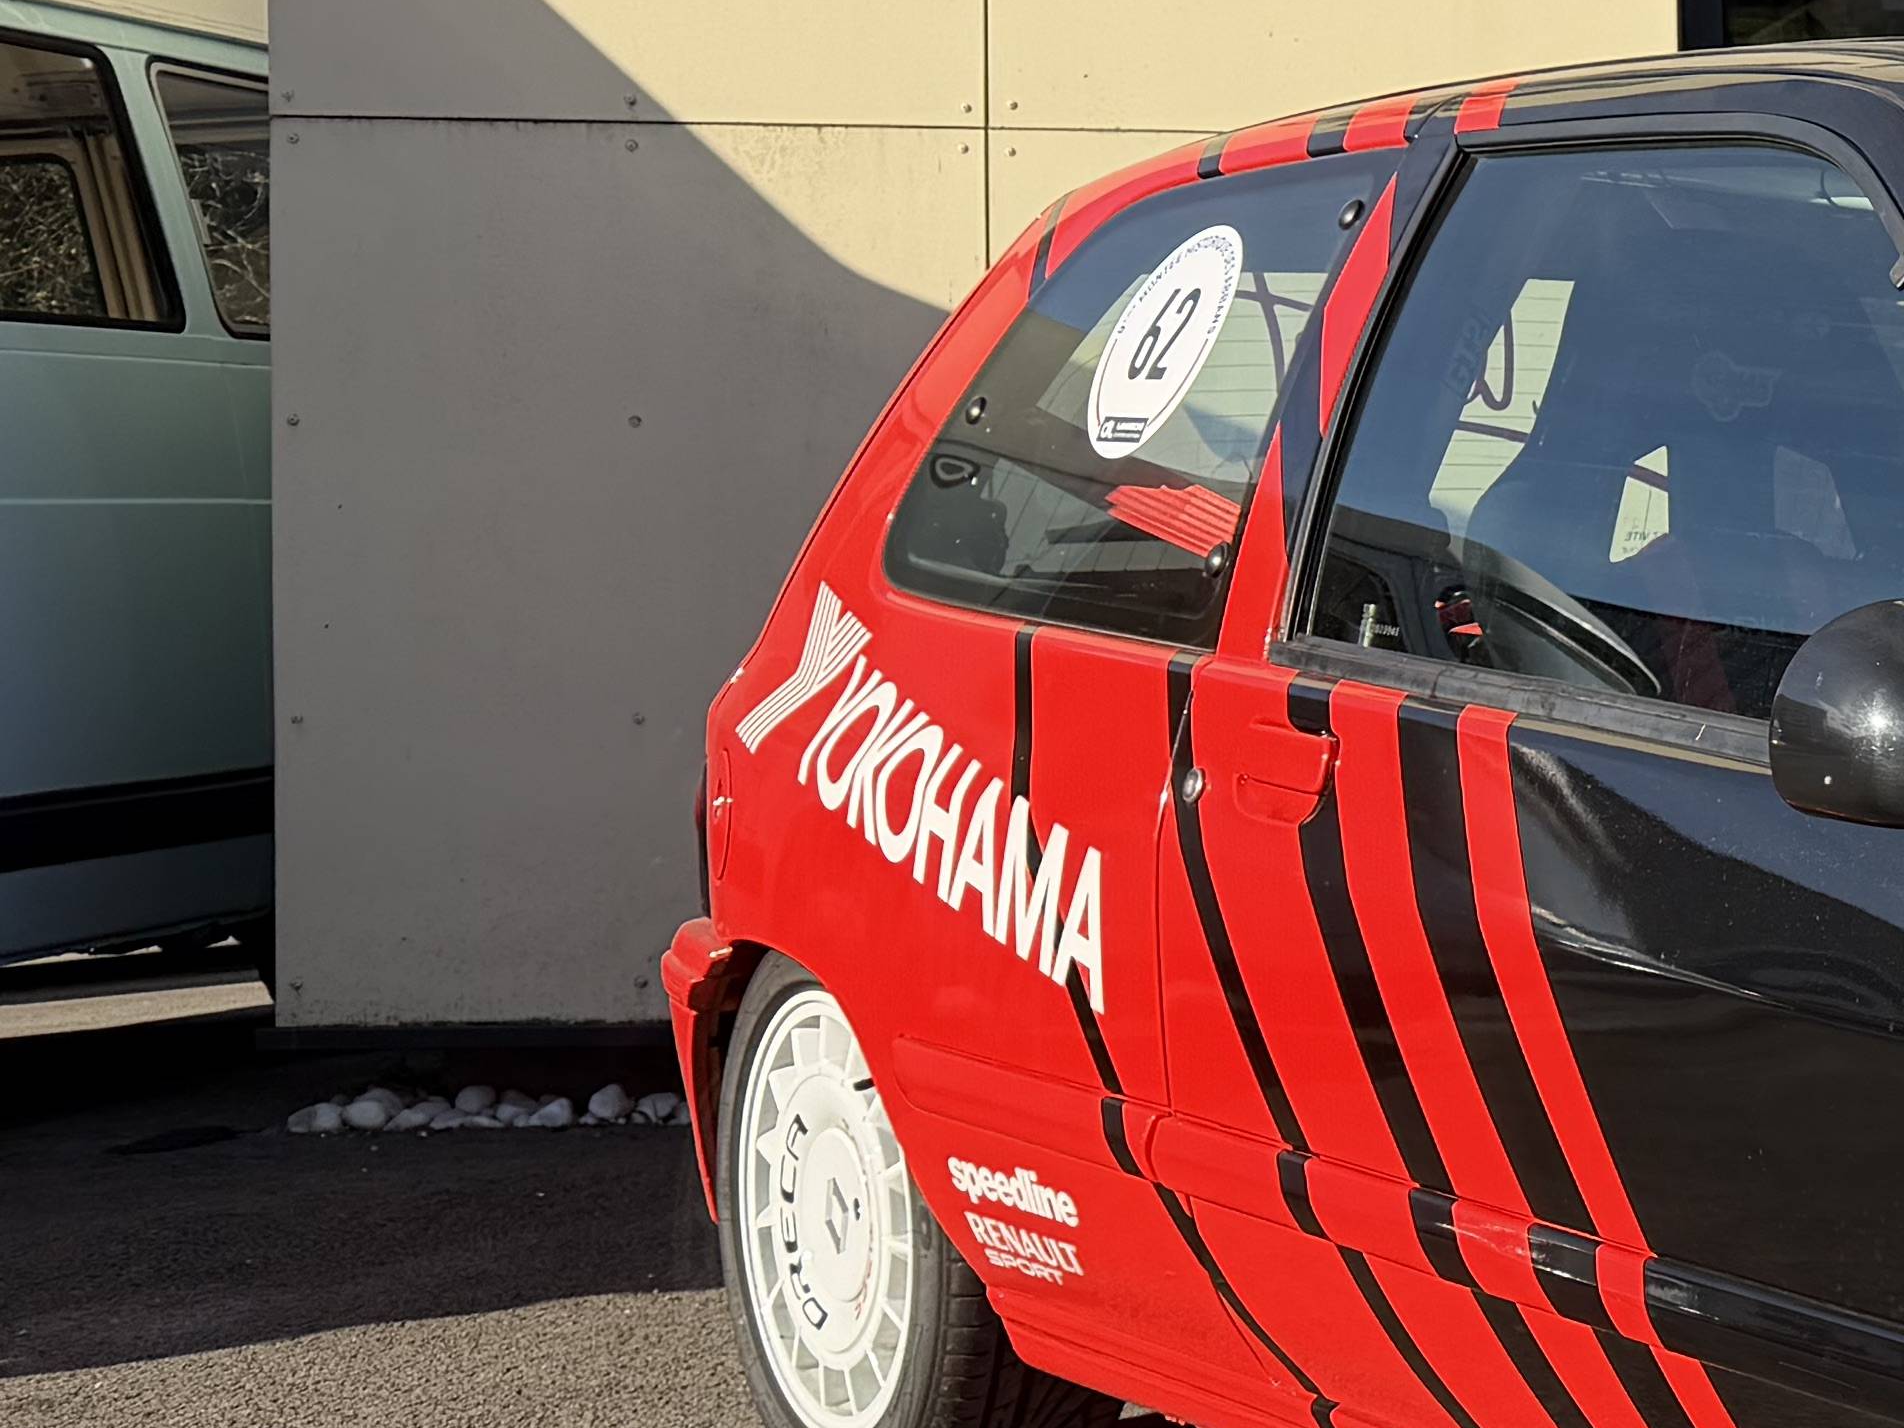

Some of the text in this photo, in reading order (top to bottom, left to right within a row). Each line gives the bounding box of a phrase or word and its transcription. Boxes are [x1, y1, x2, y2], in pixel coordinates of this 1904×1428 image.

[1127, 287, 1202, 381] 62
[798, 656, 1105, 1015] YOKOHAMA
[779, 1114, 829, 1330] ORECA
[947, 1156, 1079, 1228] speedline
[963, 1210, 1085, 1276] RENAULT
[984, 1248, 1064, 1286] SPORT
